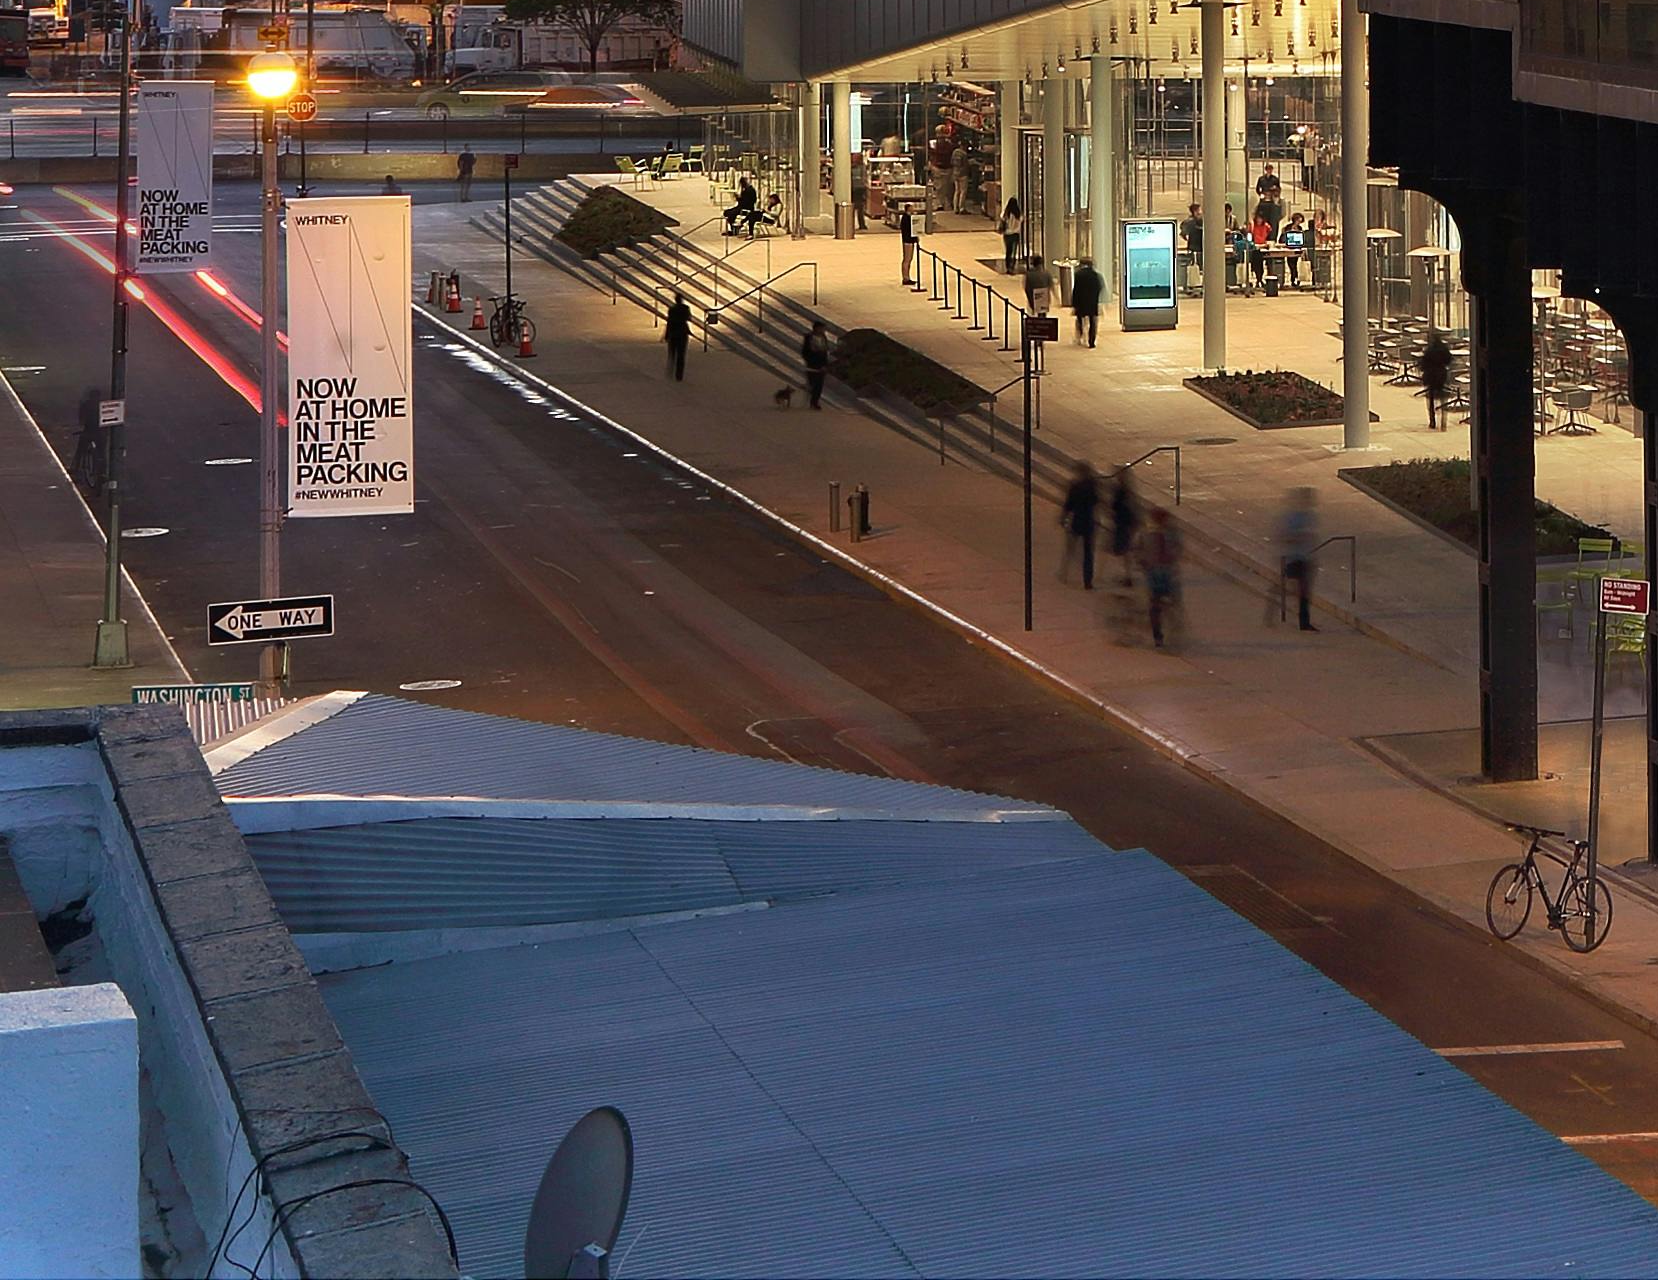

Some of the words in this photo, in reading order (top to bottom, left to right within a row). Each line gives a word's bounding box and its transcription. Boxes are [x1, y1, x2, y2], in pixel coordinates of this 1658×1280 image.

[290, 102, 315, 113] STOP
[141, 190, 179, 202] NOW
[140, 203, 159, 215] AT
[162, 202, 208, 215] HOME
[141, 216, 155, 228] IN
[158, 216, 189, 228] THE
[295, 215, 349, 225] WHITNEY
[140, 229, 183, 241] MEAT
[140, 241, 208, 255] PACKING
[296, 378, 357, 399] NOW
[295, 400, 326, 420] AT
[331, 397, 406, 419] HOME
[296, 421, 319, 442] IN
[325, 420, 375, 441] THE
[296, 442, 366, 463] MEAT
[296, 461, 408, 485] PACKING
[295, 487, 384, 500] #NEWWHITNEY
[227, 613, 263, 631] ONE
[279, 608, 317, 627] WAY
[137, 688, 233, 705] WASHINGTON
[239, 687, 251, 699] ST
